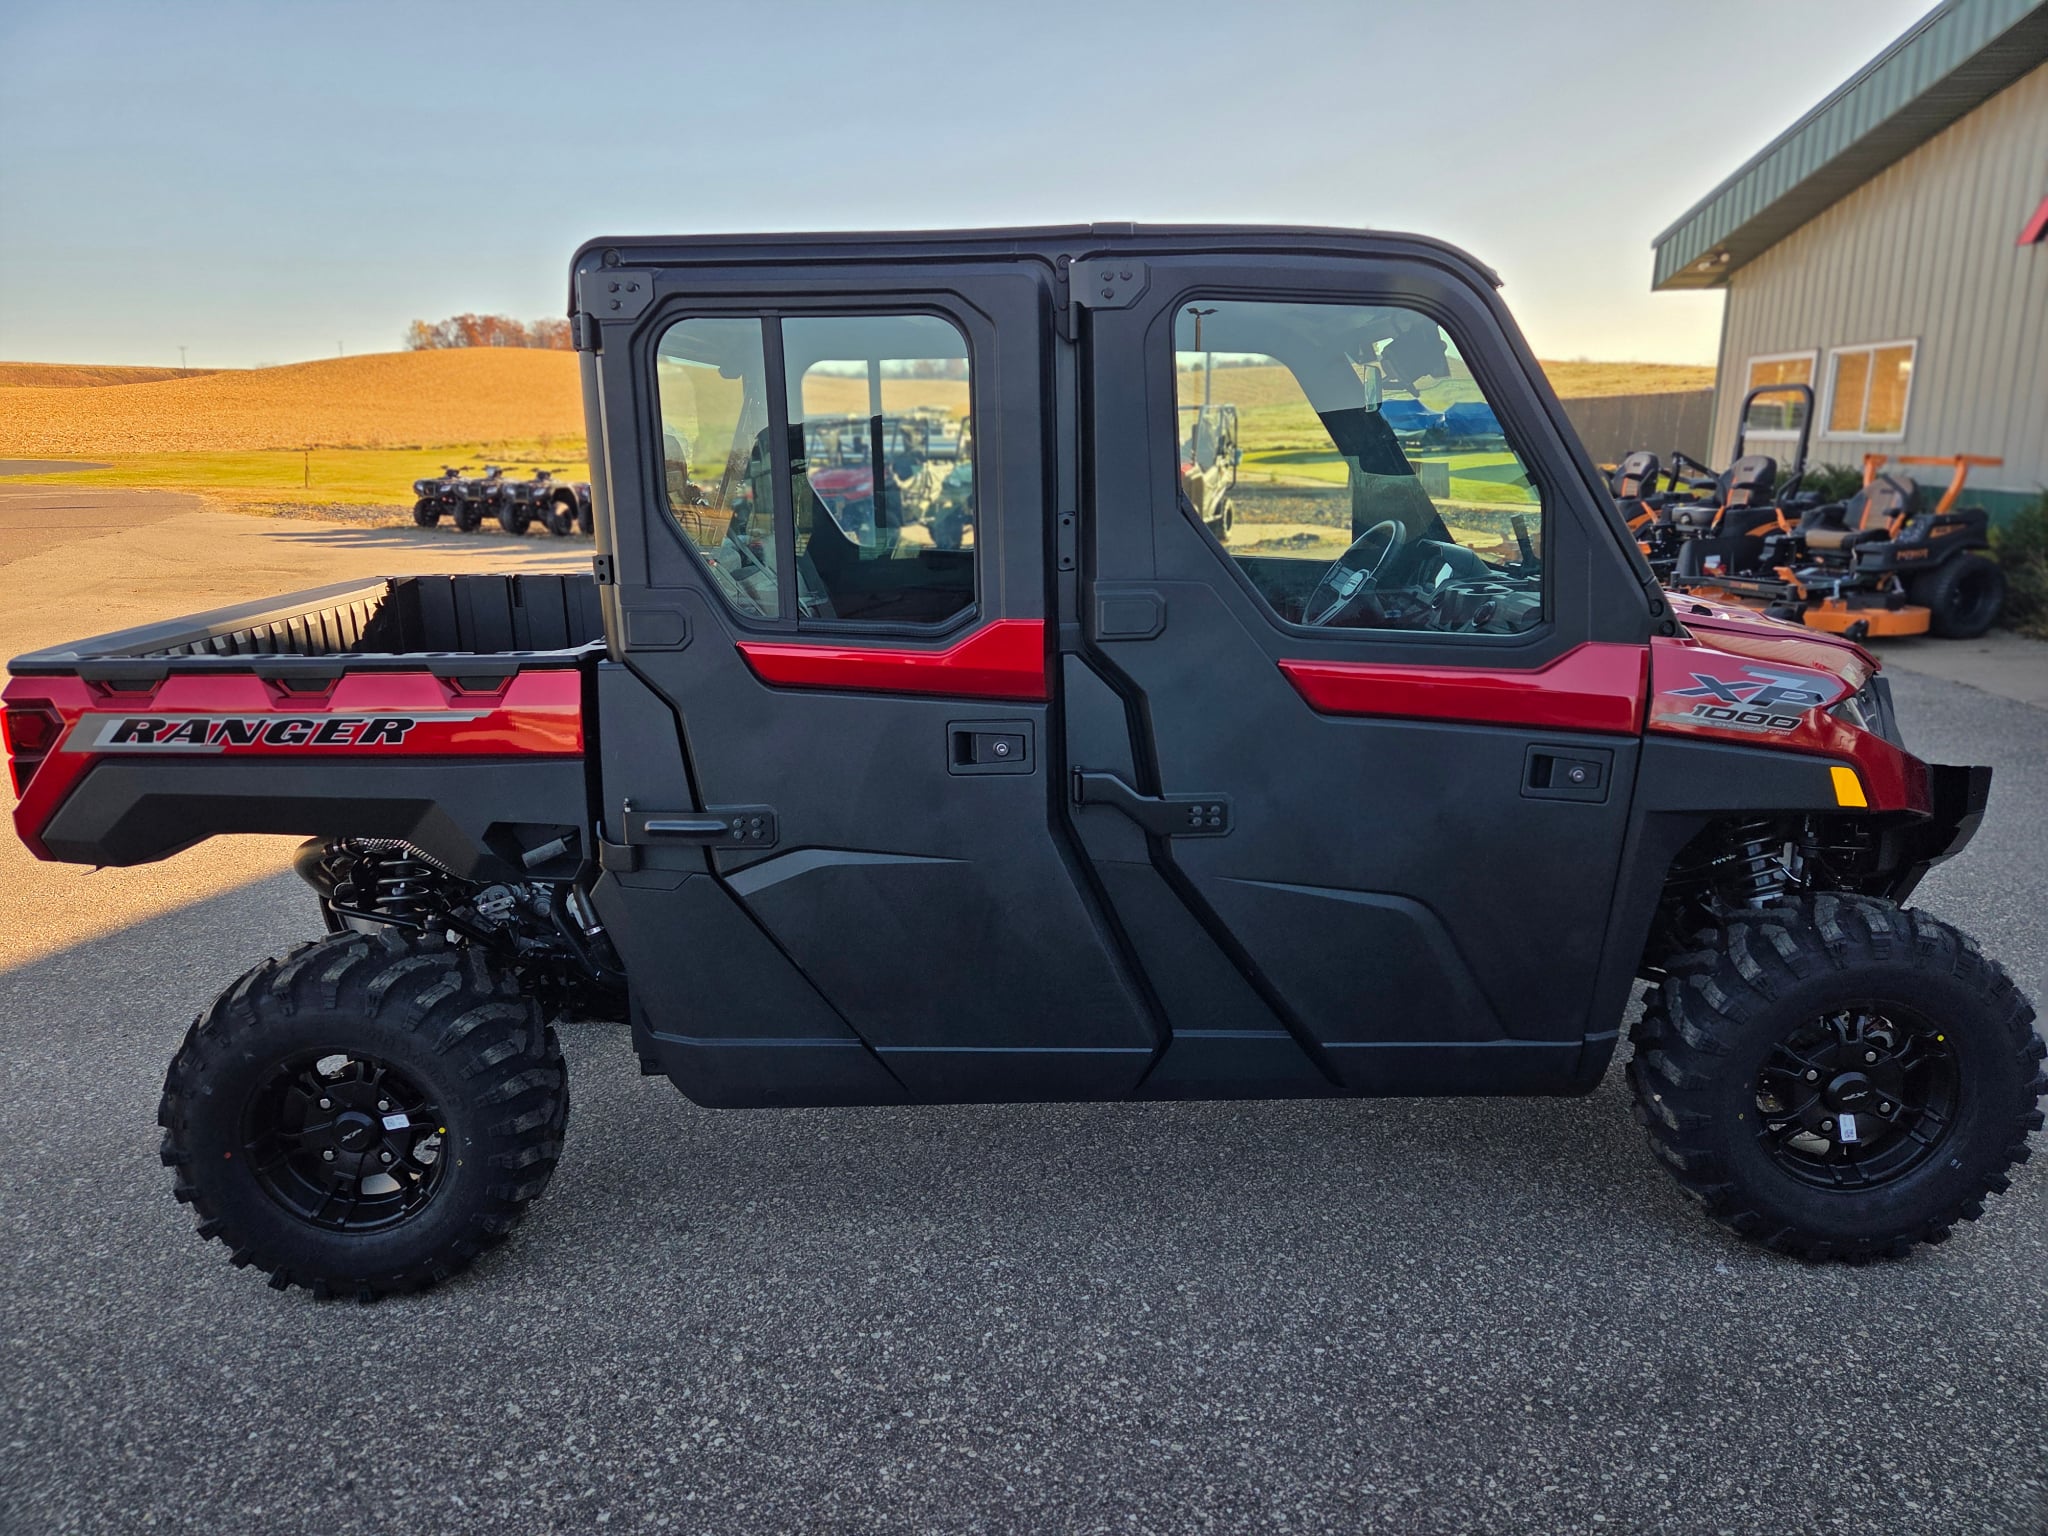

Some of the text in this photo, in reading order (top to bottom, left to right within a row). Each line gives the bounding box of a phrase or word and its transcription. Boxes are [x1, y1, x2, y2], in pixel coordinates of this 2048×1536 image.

[1663, 672, 1827, 706] XP
[109, 717, 416, 746] RANGER
[1691, 703, 1803, 731] 1000
